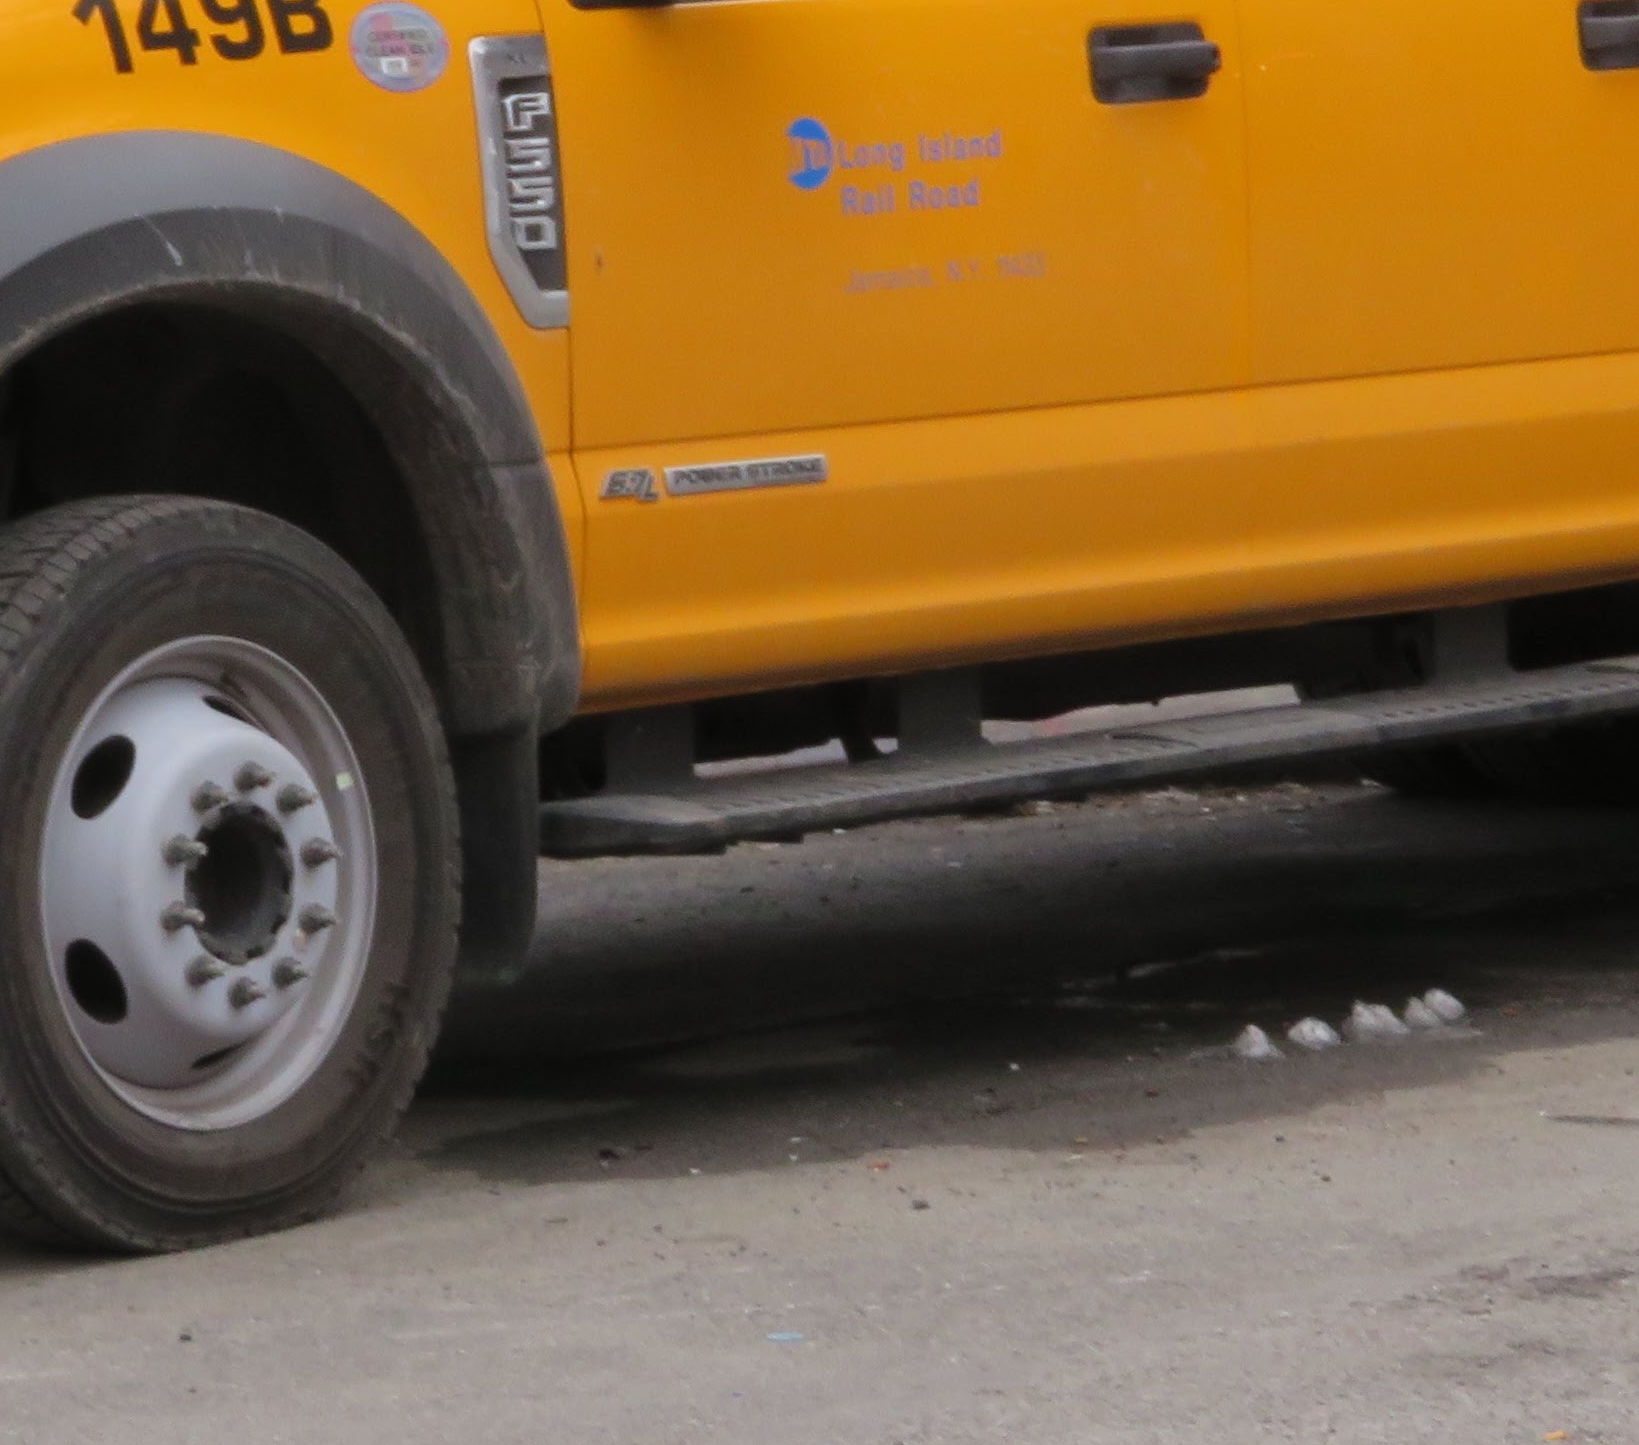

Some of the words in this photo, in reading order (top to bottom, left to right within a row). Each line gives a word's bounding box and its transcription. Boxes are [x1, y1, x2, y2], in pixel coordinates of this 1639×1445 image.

[503, 92, 557, 250] F550
[838, 139, 905, 172] Long
[919, 128, 1003, 163] Island
[841, 182, 898, 218] Rail
[909, 178, 980, 211] Road
